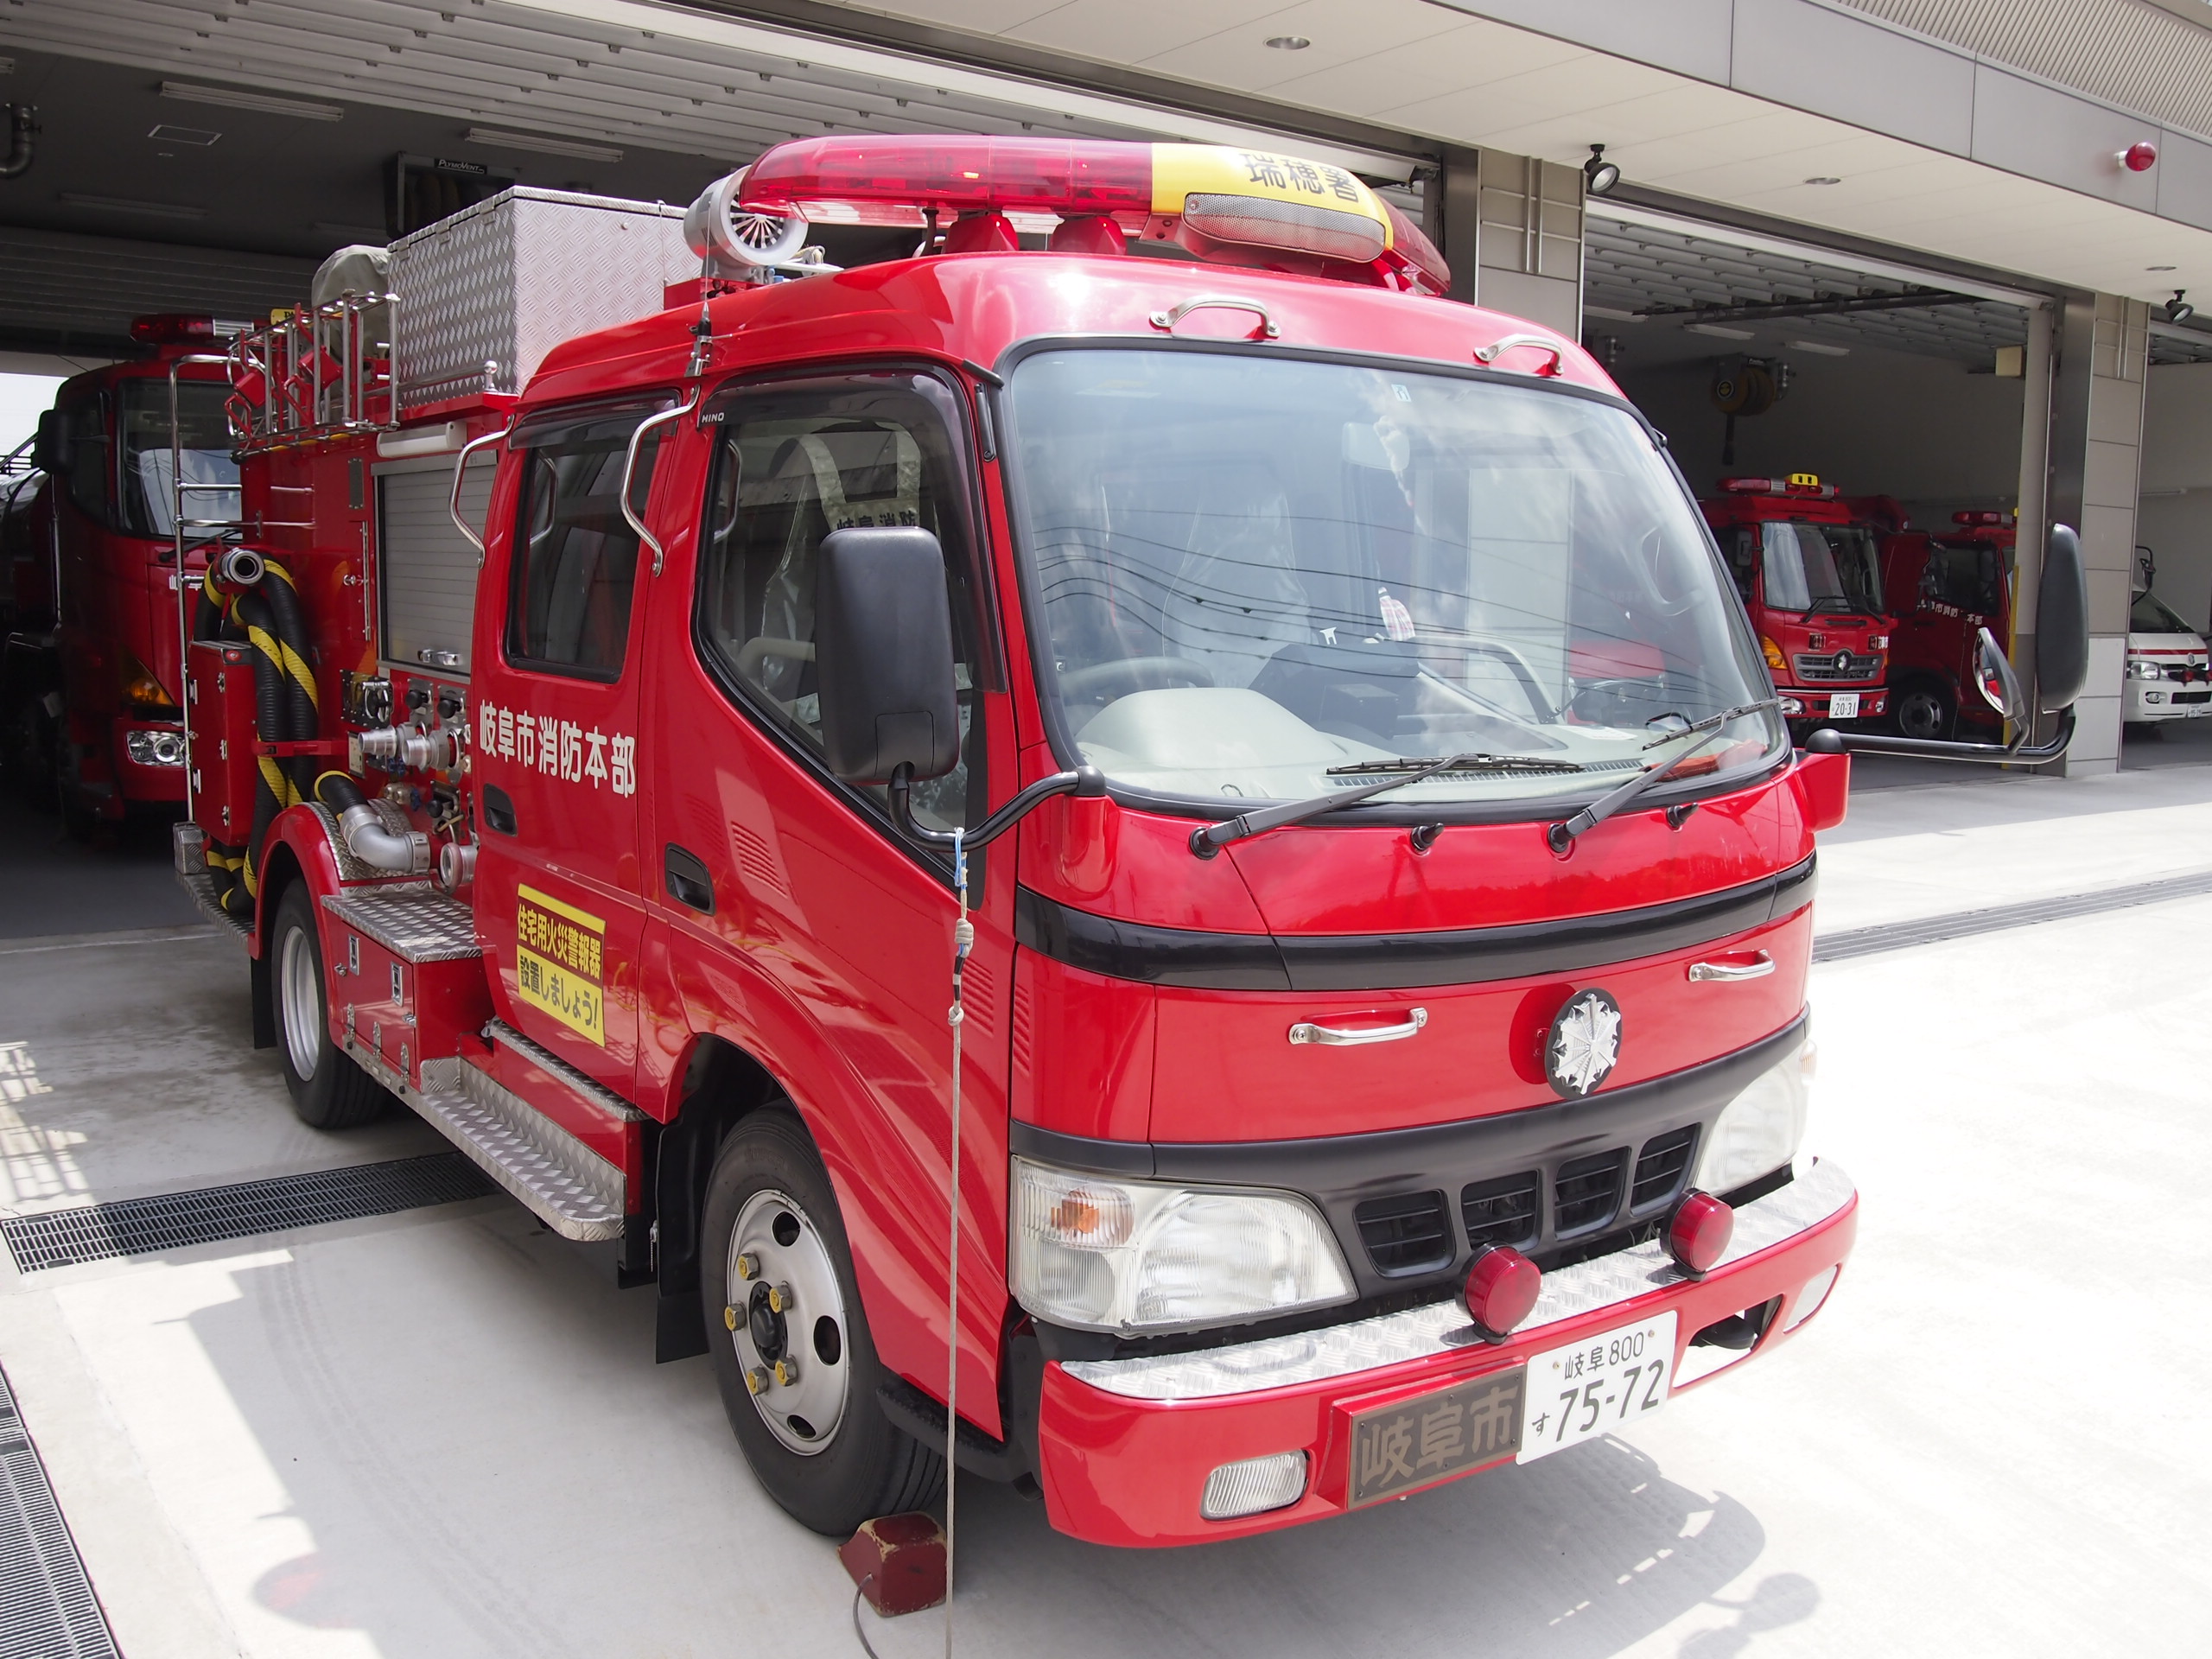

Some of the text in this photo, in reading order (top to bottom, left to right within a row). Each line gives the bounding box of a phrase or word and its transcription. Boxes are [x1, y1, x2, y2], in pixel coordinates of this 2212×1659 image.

[1239, 153, 1359, 203] 瑞穂署
[702, 412, 724, 423] HINO
[480, 699, 636, 798] 岐阜市消防本部
[518, 903, 601, 980] 住宅用火災警報器
[1360, 1386, 1518, 1488] 岐阜市
[1532, 1359, 1664, 1442] す 75-72
